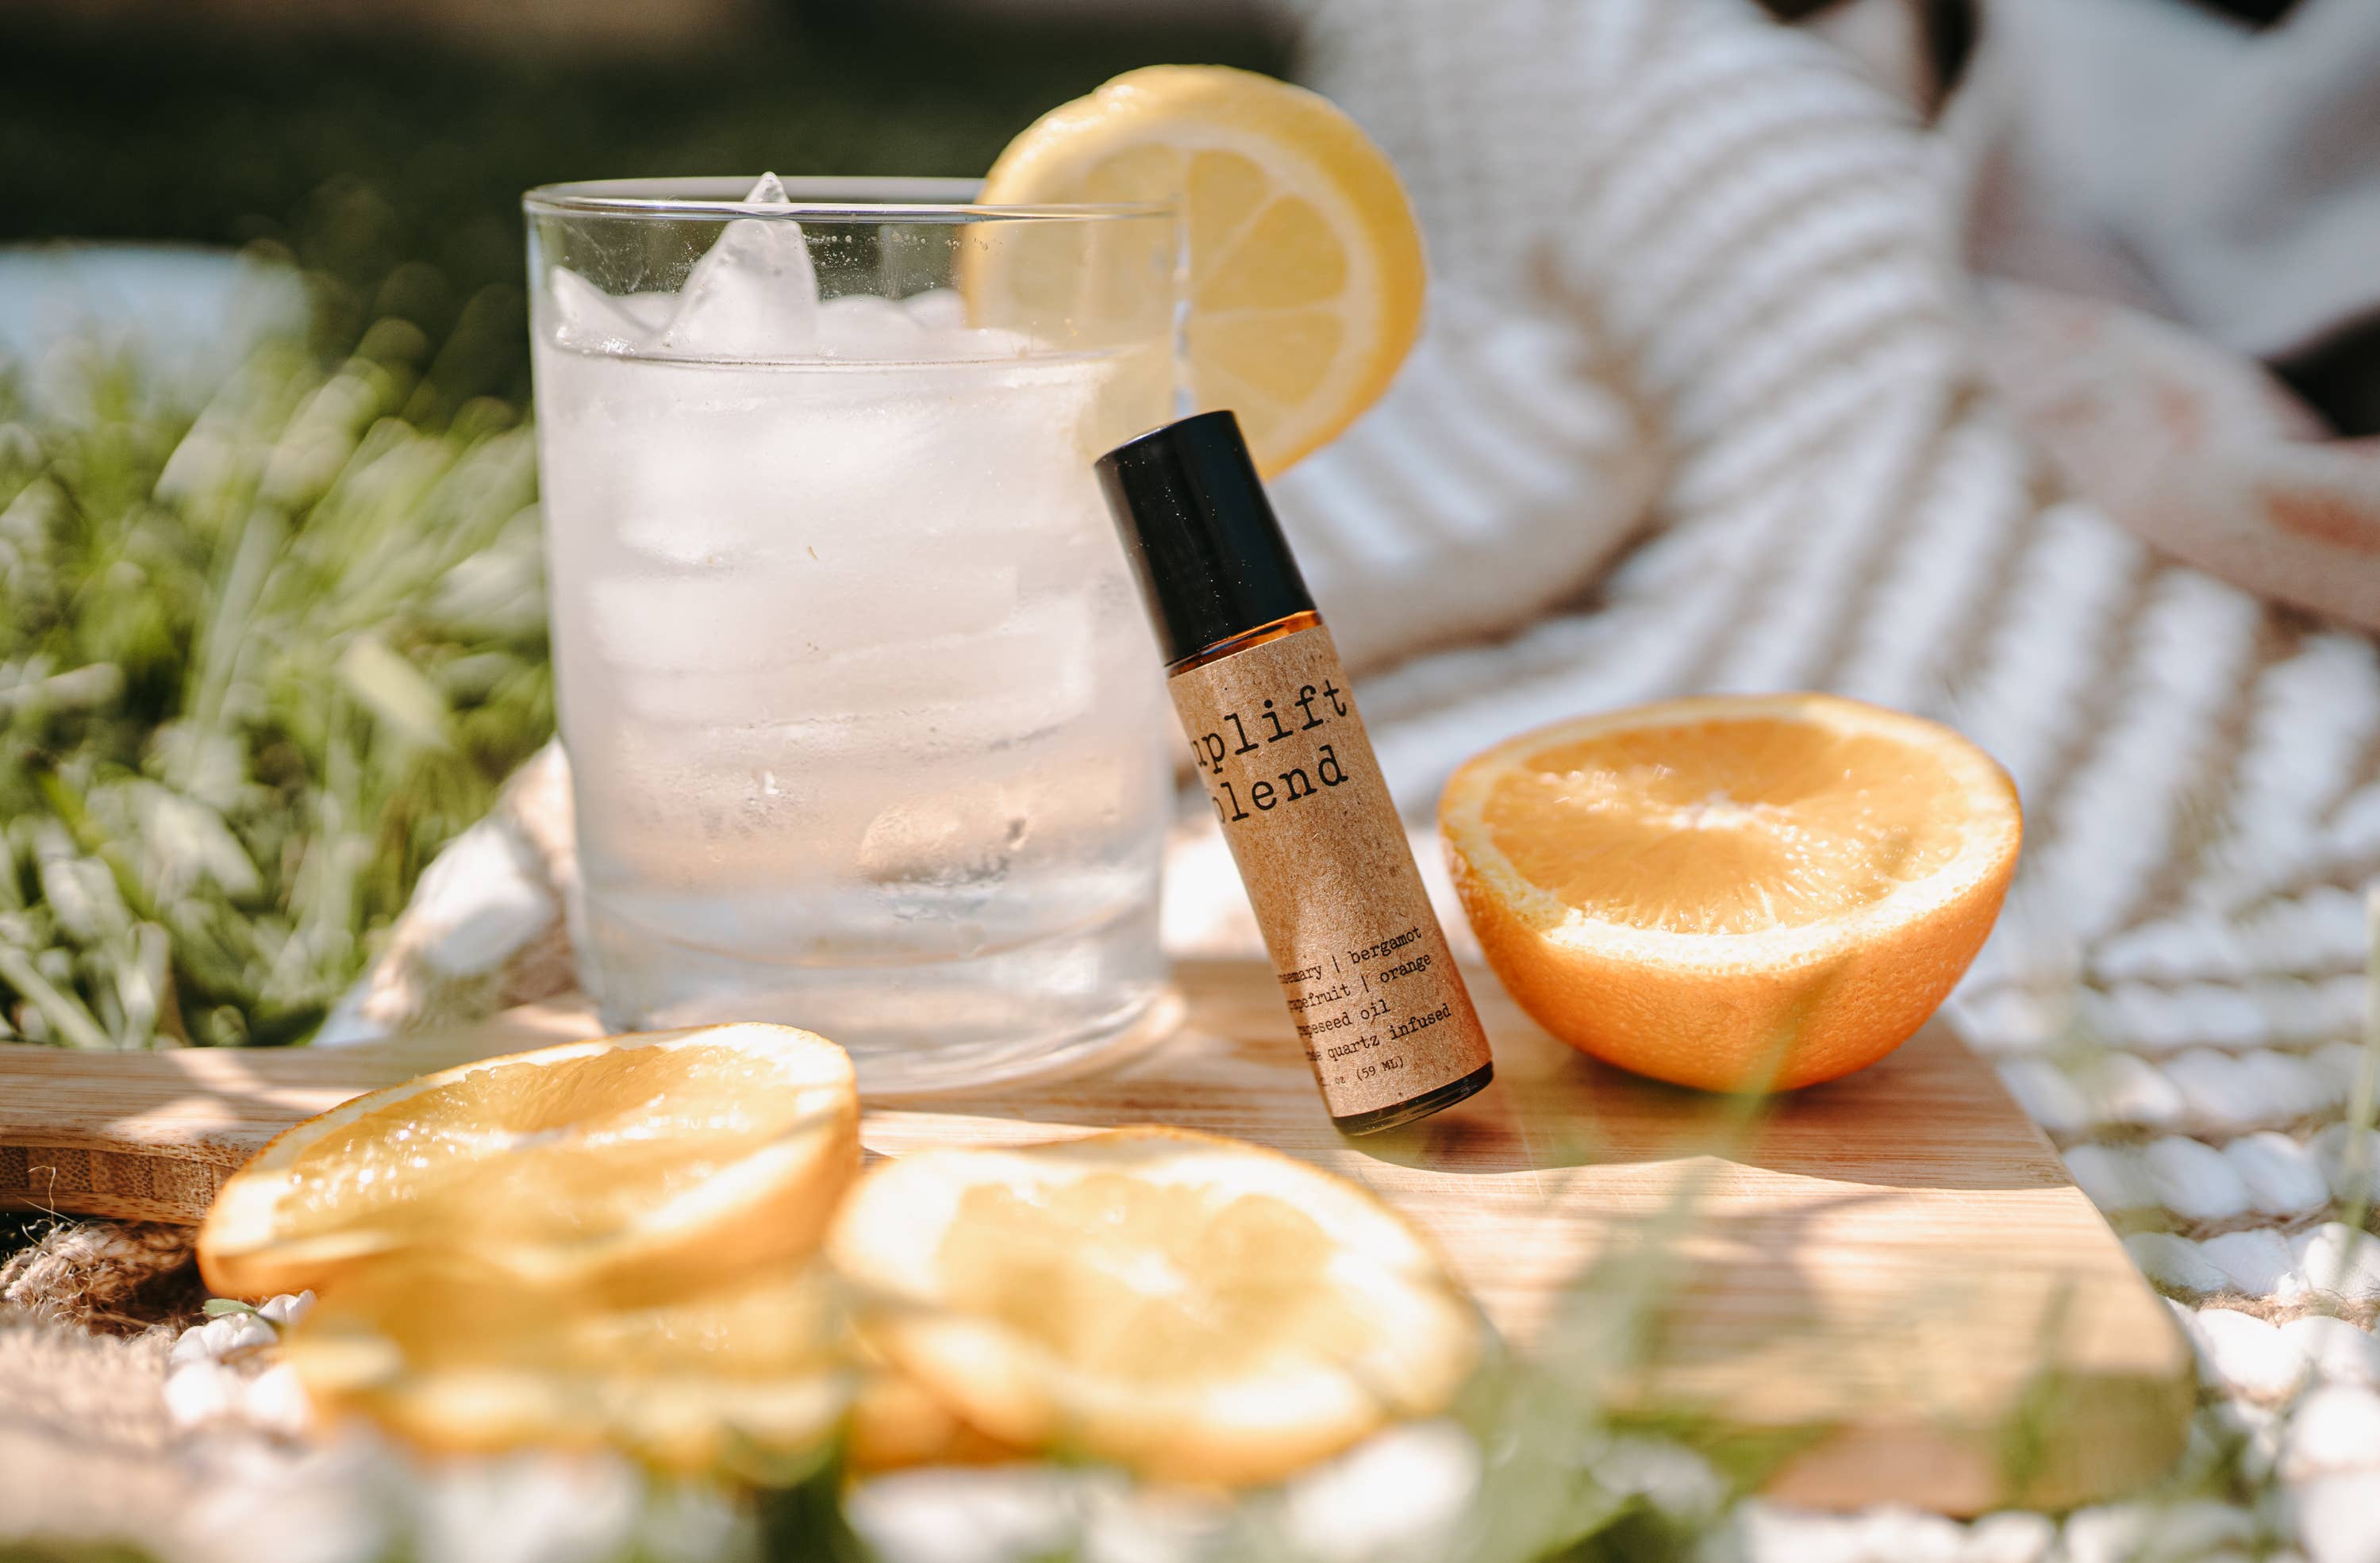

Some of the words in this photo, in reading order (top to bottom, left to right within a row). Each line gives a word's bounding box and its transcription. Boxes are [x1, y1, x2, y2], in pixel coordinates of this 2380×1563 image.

[1348, 925, 1423, 965] bergamot
[1378, 952, 1432, 984] orange
[1359, 999, 1391, 1021] oil
[1327, 1035, 1381, 1062] quartz
[1389, 1003, 1452, 1041] infused
[1355, 1065, 1377, 1082] (59
[1381, 1054, 1404, 1072] ML)
